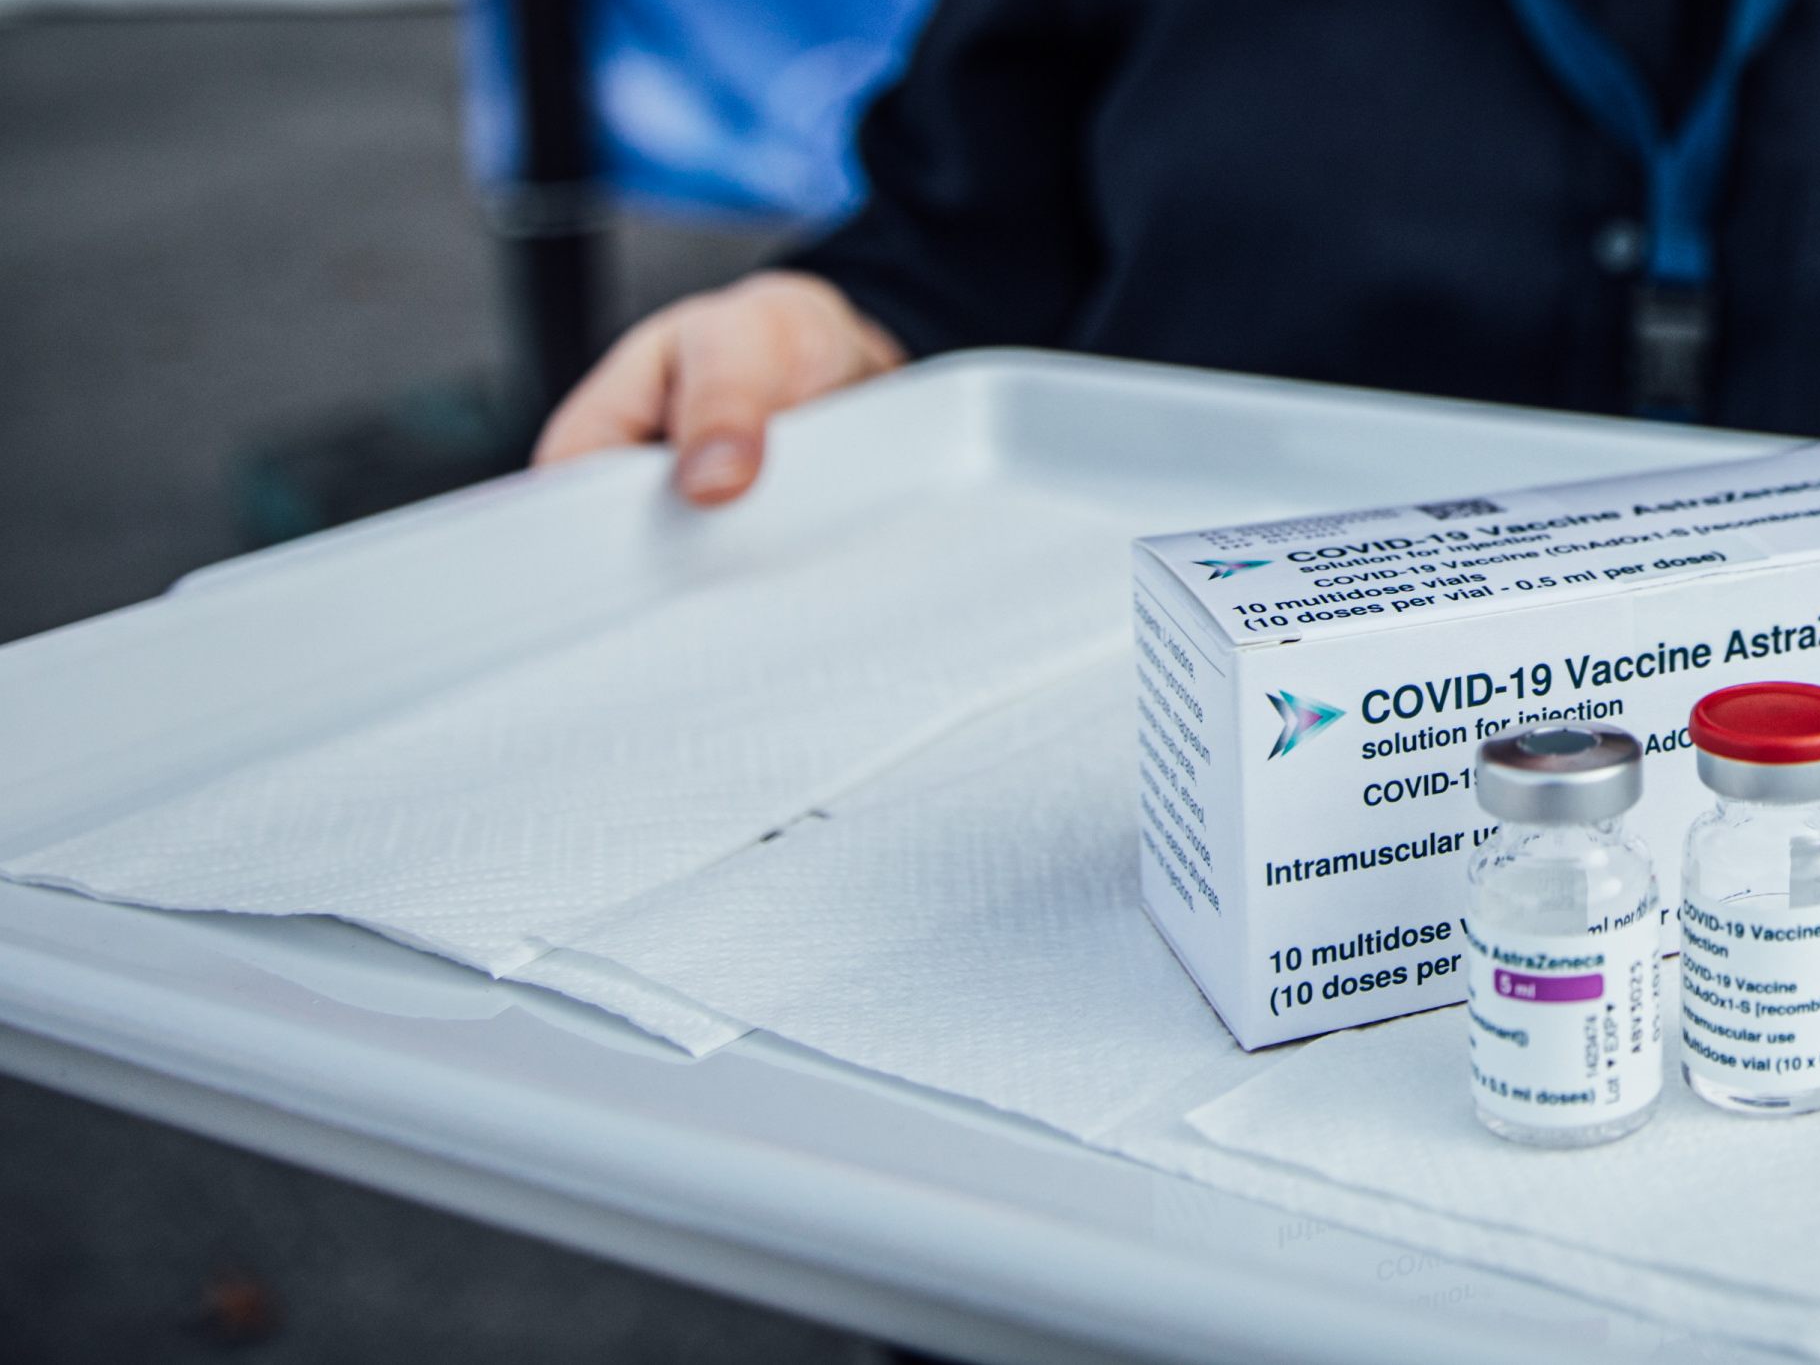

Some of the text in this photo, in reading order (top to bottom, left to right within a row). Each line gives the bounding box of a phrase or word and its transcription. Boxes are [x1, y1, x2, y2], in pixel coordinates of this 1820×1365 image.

[1286, 530, 1471, 563] COVID-19
[1475, 508, 1621, 538] Vaccine
[1299, 531, 1552, 575] solution for injection
[1313, 557, 1437, 589] COVID-19
[1441, 546, 1542, 572] Vaccine
[1231, 571, 1488, 617] 10 multidose vials
[1243, 615, 1290, 633] (10
[1296, 600, 1386, 626] doses
[1390, 595, 1437, 615] per
[1443, 584, 1495, 604] vial
[1514, 575, 1558, 594] 0.5
[1563, 569, 1598, 585] ml
[1603, 561, 1646, 582] per
[1652, 549, 1728, 572] dose)
[1361, 663, 1553, 725] COVID-19
[1564, 642, 1713, 690] Vaccine
[1361, 722, 1468, 761] solution
[1475, 717, 1511, 741] for
[1363, 766, 1479, 807] COVID-1
[1266, 824, 1466, 887] Intramuscular
[1269, 946, 1303, 974] 10
[1311, 920, 1452, 967] multidose
[1492, 944, 1605, 969] AstraZeneca
[1269, 953, 1463, 1018] (10 doses per
[1735, 976, 1798, 995] Vaccine
[1767, 1032, 1796, 1044] use
[1742, 1056, 1771, 1072] vial
[1776, 1057, 1802, 1075] (10
[1806, 1057, 1816, 1070] x
[1535, 1087, 1596, 1106] doses)
